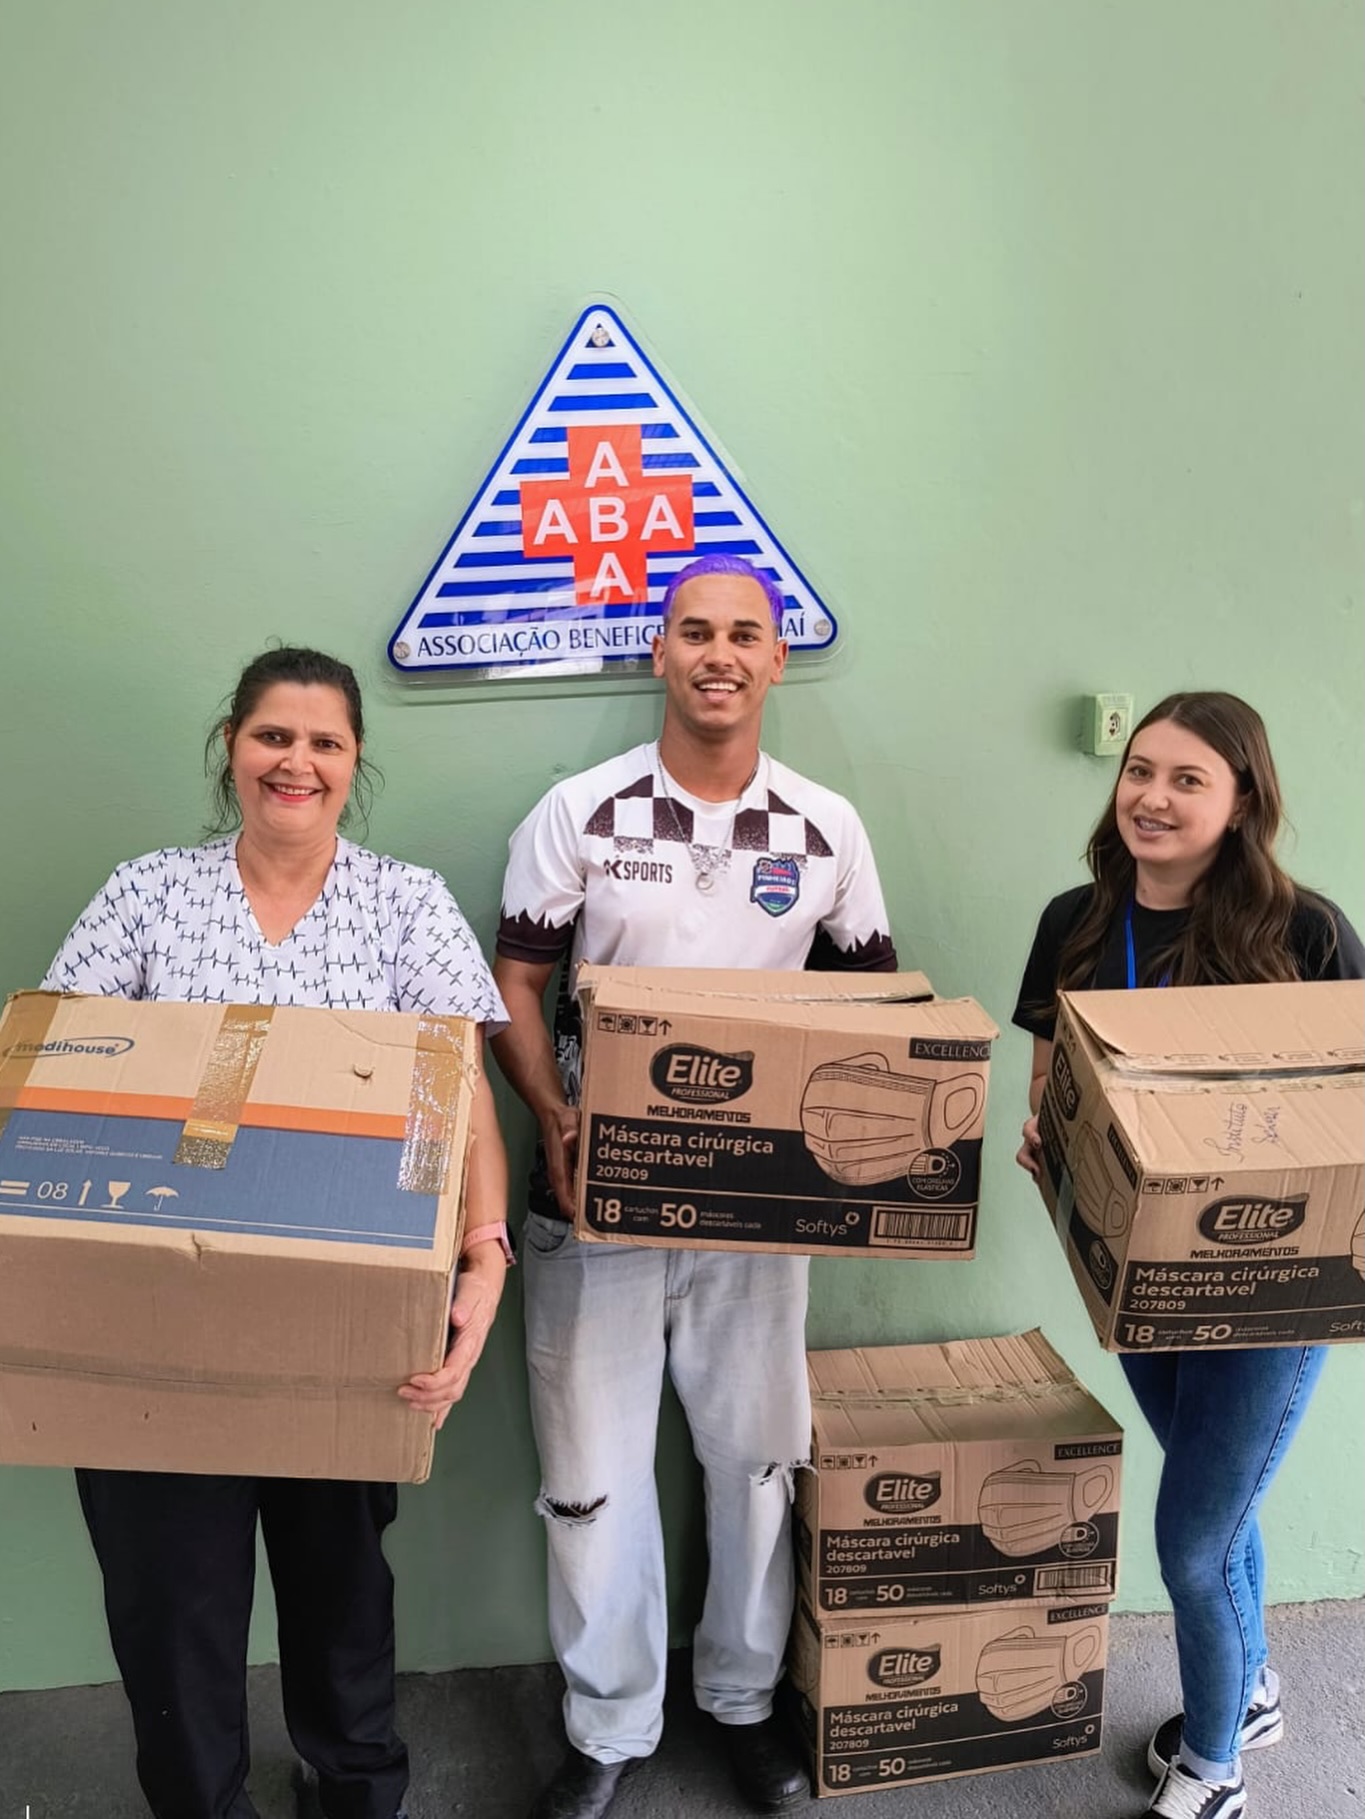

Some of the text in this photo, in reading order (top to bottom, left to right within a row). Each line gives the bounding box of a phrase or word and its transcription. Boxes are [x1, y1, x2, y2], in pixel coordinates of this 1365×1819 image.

[584, 441, 629, 488] A
[589, 552, 634, 597] A
[418, 627, 560, 656] ASSOCIAÇÃO
[915, 1043, 991, 1058] EXCELLENC
[666, 1054, 741, 1087] Elite
[647, 1105, 751, 1123] MELHORAMENTOS
[599, 1123, 773, 1156] Máscara cirúrgica
[597, 1143, 713, 1168] descartavel
[596, 1164, 648, 1180] 207809
[37, 1180, 69, 1200] 08
[594, 1197, 621, 1223] 18
[660, 1203, 697, 1229] 50
[1214, 1203, 1294, 1230] Elite
[795, 1218, 847, 1237] Softys
[1190, 1247, 1299, 1259] MELHORAMENTOS
[1135, 1264, 1319, 1284] Máscara cirúrgica
[1132, 1282, 1256, 1297] descartavel
[1129, 1299, 1186, 1310] 207809
[1124, 1323, 1154, 1342] 18
[1193, 1324, 1232, 1341] 50
[1329, 1319, 1365, 1333] Soft
[876, 1479, 932, 1502] Elite
[827, 1531, 960, 1548] Máscara cirúrgica
[826, 1547, 915, 1562] descartavel
[826, 1564, 866, 1574] 207809
[825, 1587, 847, 1605] 18
[876, 1584, 904, 1601] 50
[978, 1583, 1017, 1595] Softys
[879, 1652, 932, 1676] Elite
[830, 1702, 959, 1724] Máscara cirúrgica
[829, 1719, 916, 1737] descartavel
[829, 1739, 869, 1750] 207809
[1053, 1735, 1087, 1749] Softys
[829, 1764, 850, 1782] 18
[879, 1758, 905, 1776] 50
